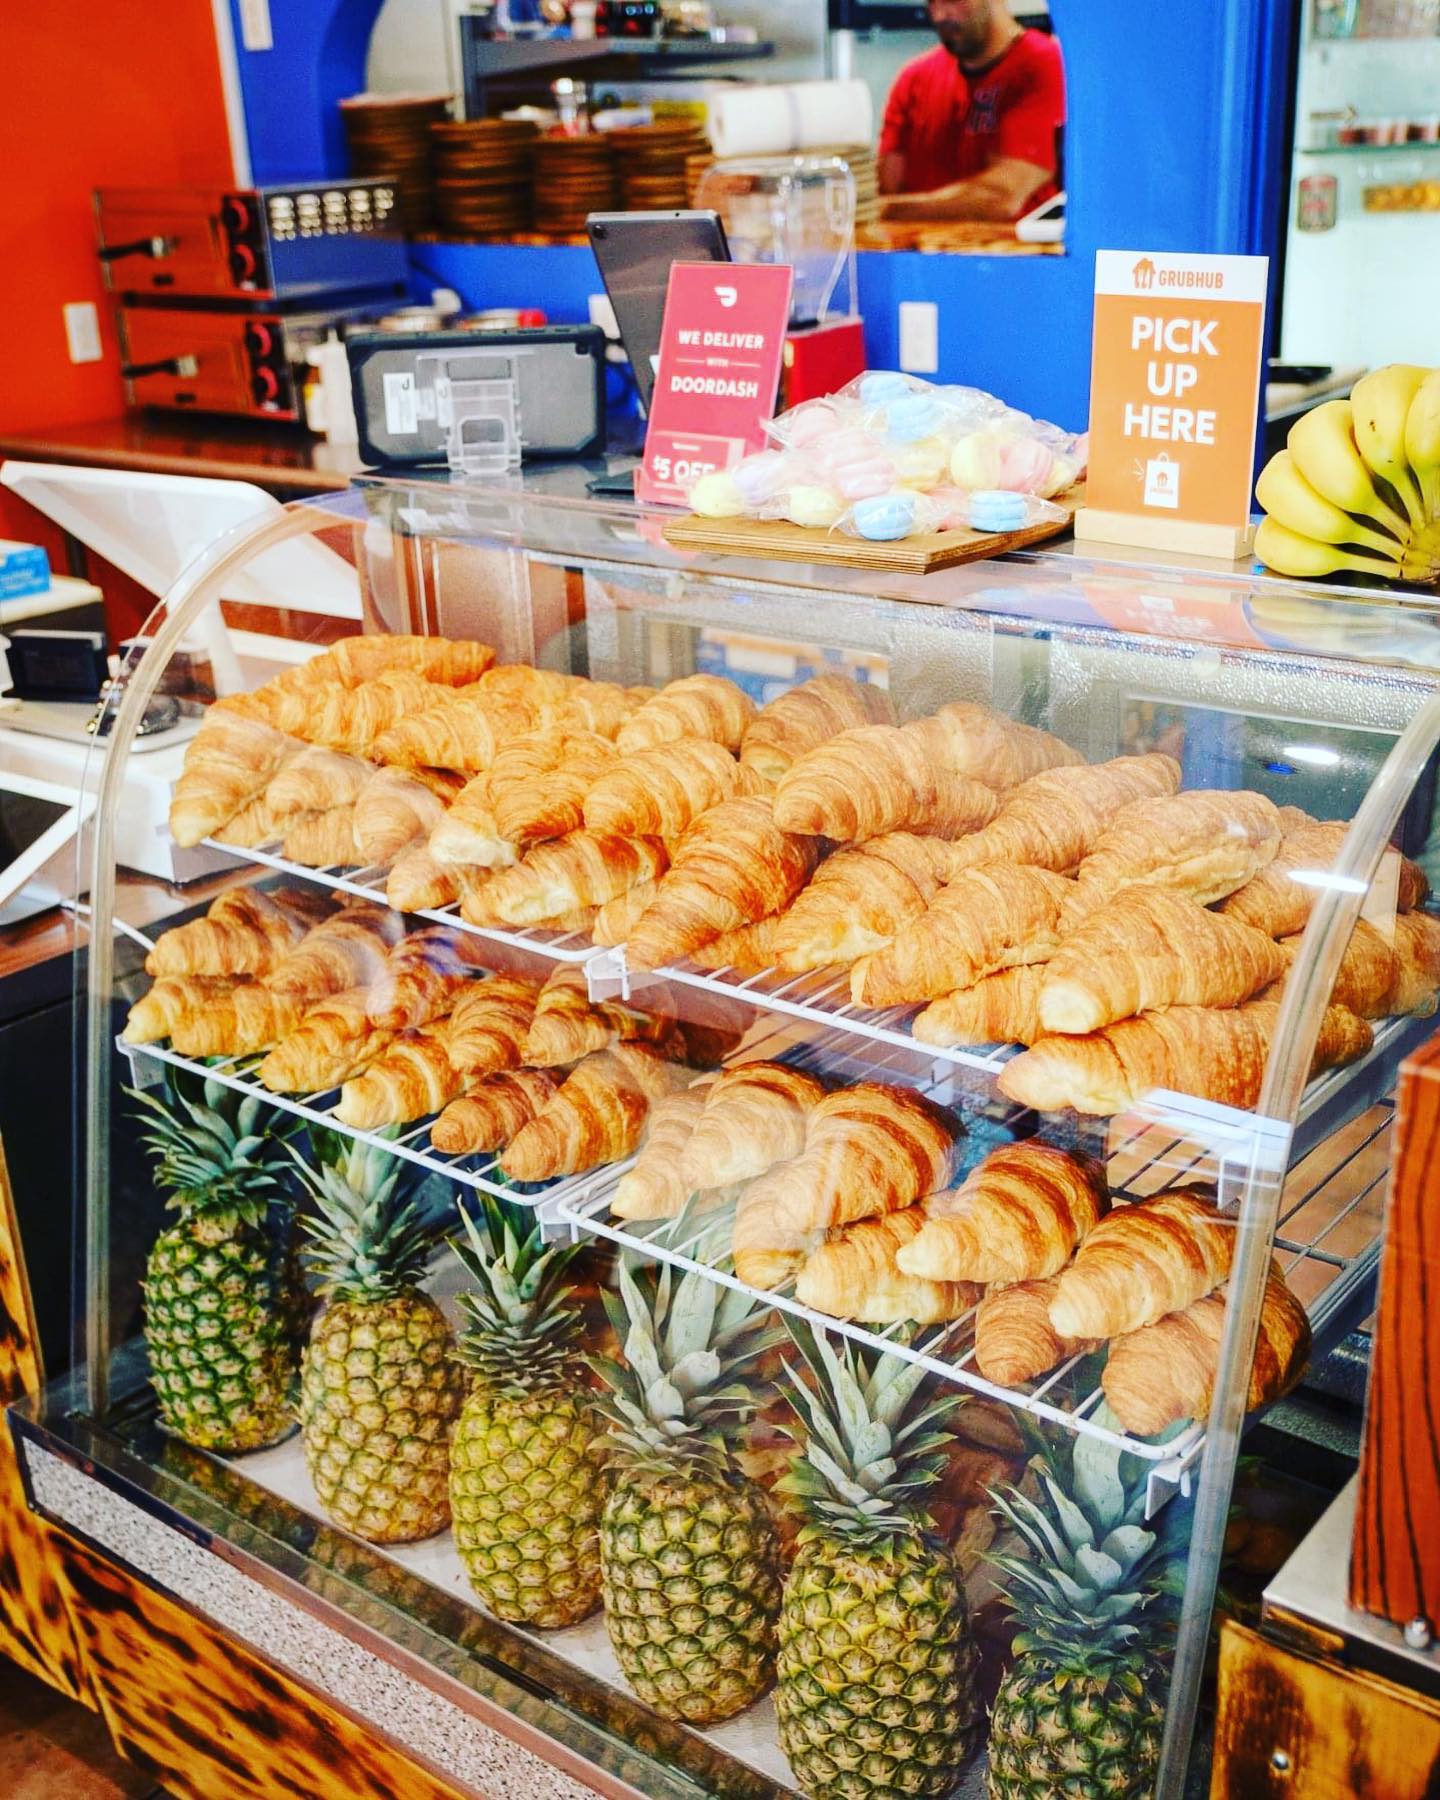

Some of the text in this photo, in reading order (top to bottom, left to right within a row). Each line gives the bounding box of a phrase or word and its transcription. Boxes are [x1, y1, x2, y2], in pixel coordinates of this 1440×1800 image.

[1158, 269, 1224, 289] GRUBHUB
[679, 330, 764, 349] WE DELIVER
[1131, 316, 1219, 355] PICK
[671, 375, 759, 399] DOORDASH
[1147, 361, 1197, 398] UP
[1123, 403, 1217, 446] HERE
[653, 454, 671, 480] $5
